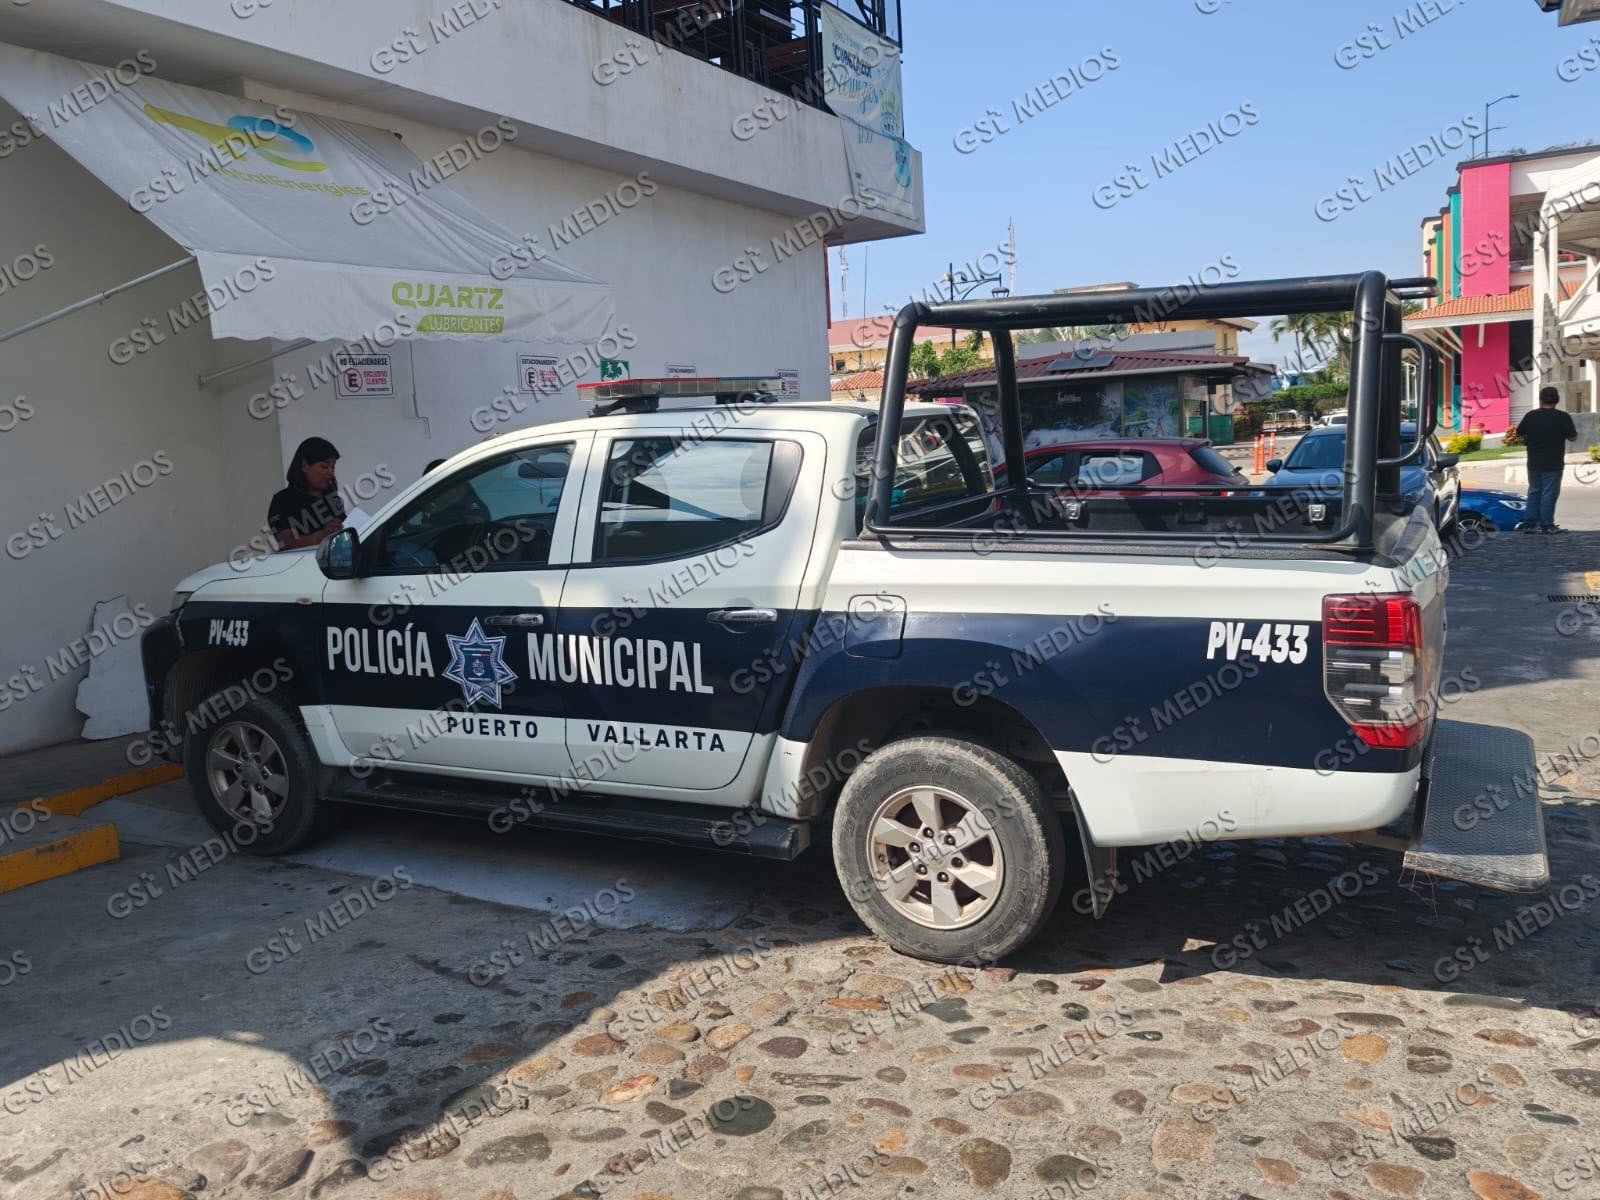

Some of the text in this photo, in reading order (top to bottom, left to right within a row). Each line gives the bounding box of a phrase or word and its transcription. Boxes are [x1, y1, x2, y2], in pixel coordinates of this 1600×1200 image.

[391, 281, 505, 310] QUARTZ
[428, 316, 502, 333] LUBRICANTES
[208, 619, 250, 647] PV-433
[1206, 621, 1311, 665] PV-433
[327, 622, 715, 694] POLICÍA MUNICIPAL
[446, 715, 727, 753] PUERTO VALLARTA
